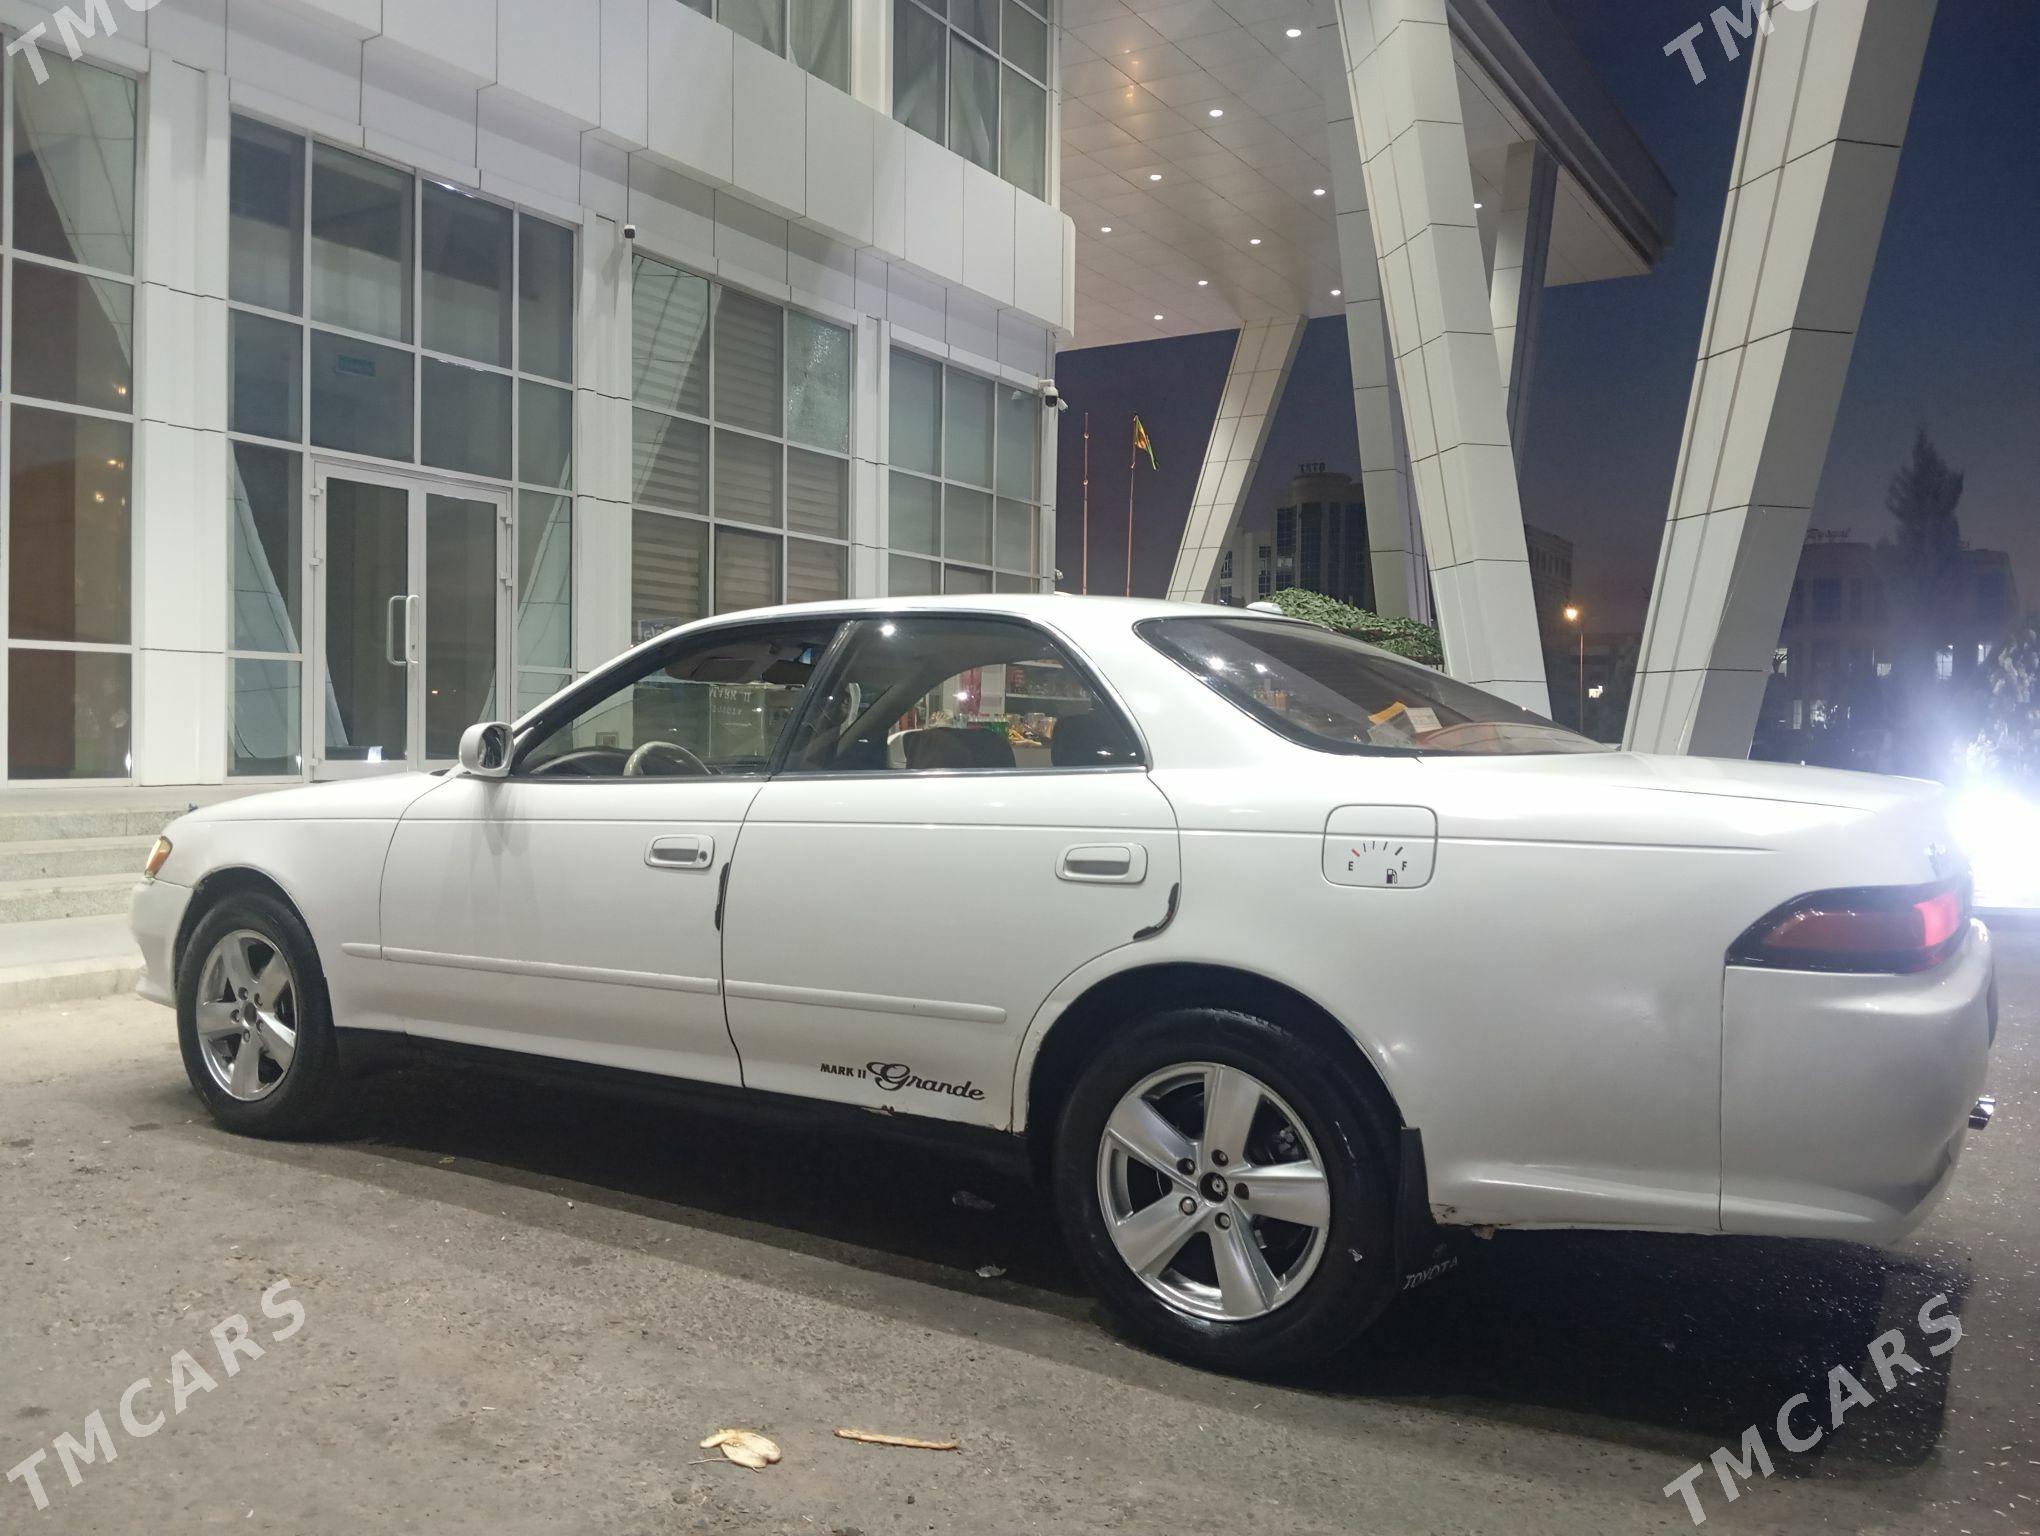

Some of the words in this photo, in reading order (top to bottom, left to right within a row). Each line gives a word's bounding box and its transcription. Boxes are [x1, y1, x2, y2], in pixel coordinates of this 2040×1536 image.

[1348, 861, 1354, 871] E
[1401, 861, 1408, 871] F
[820, 1063, 854, 1077] MARK
[857, 1068, 867, 1079] II
[866, 1061, 986, 1100] Grande
